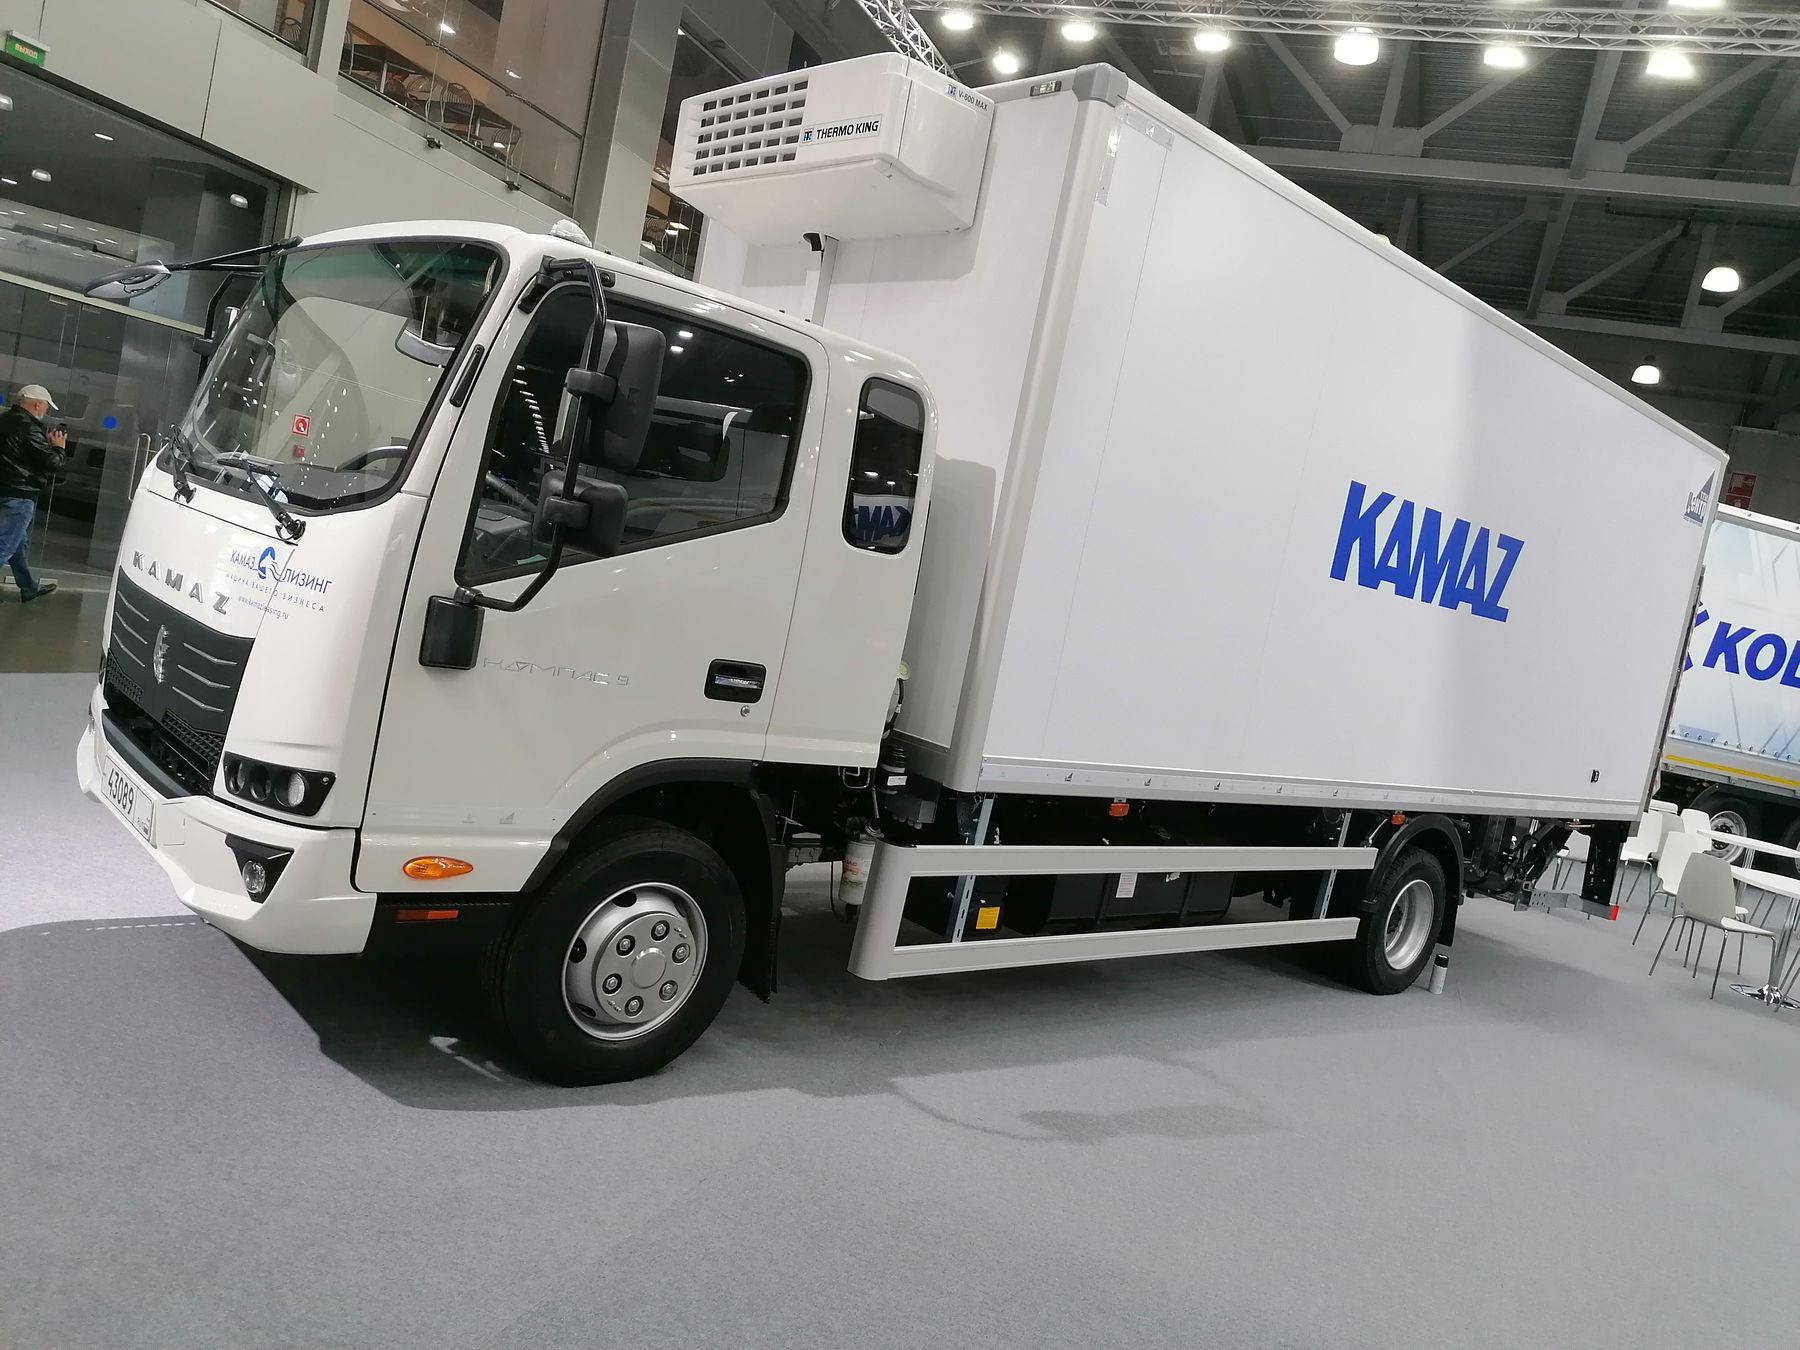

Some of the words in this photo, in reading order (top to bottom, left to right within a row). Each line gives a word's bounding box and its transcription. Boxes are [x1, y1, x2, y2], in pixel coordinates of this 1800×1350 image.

[15, 43, 38, 59] ВЫХОД
[975, 99, 988, 111] MAX
[816, 124, 855, 139] THERMO
[855, 120, 880, 134] KING
[1329, 480, 1525, 623] KAMAZ
[230, 549, 256, 570] КАМАЗ
[282, 567, 333, 594] ЛИЗИНГ
[132, 551, 230, 615] KAMAZ
[282, 592, 325, 612] БИЗНЕСА
[616, 674, 630, 686] 9
[108, 767, 135, 815] 43089
